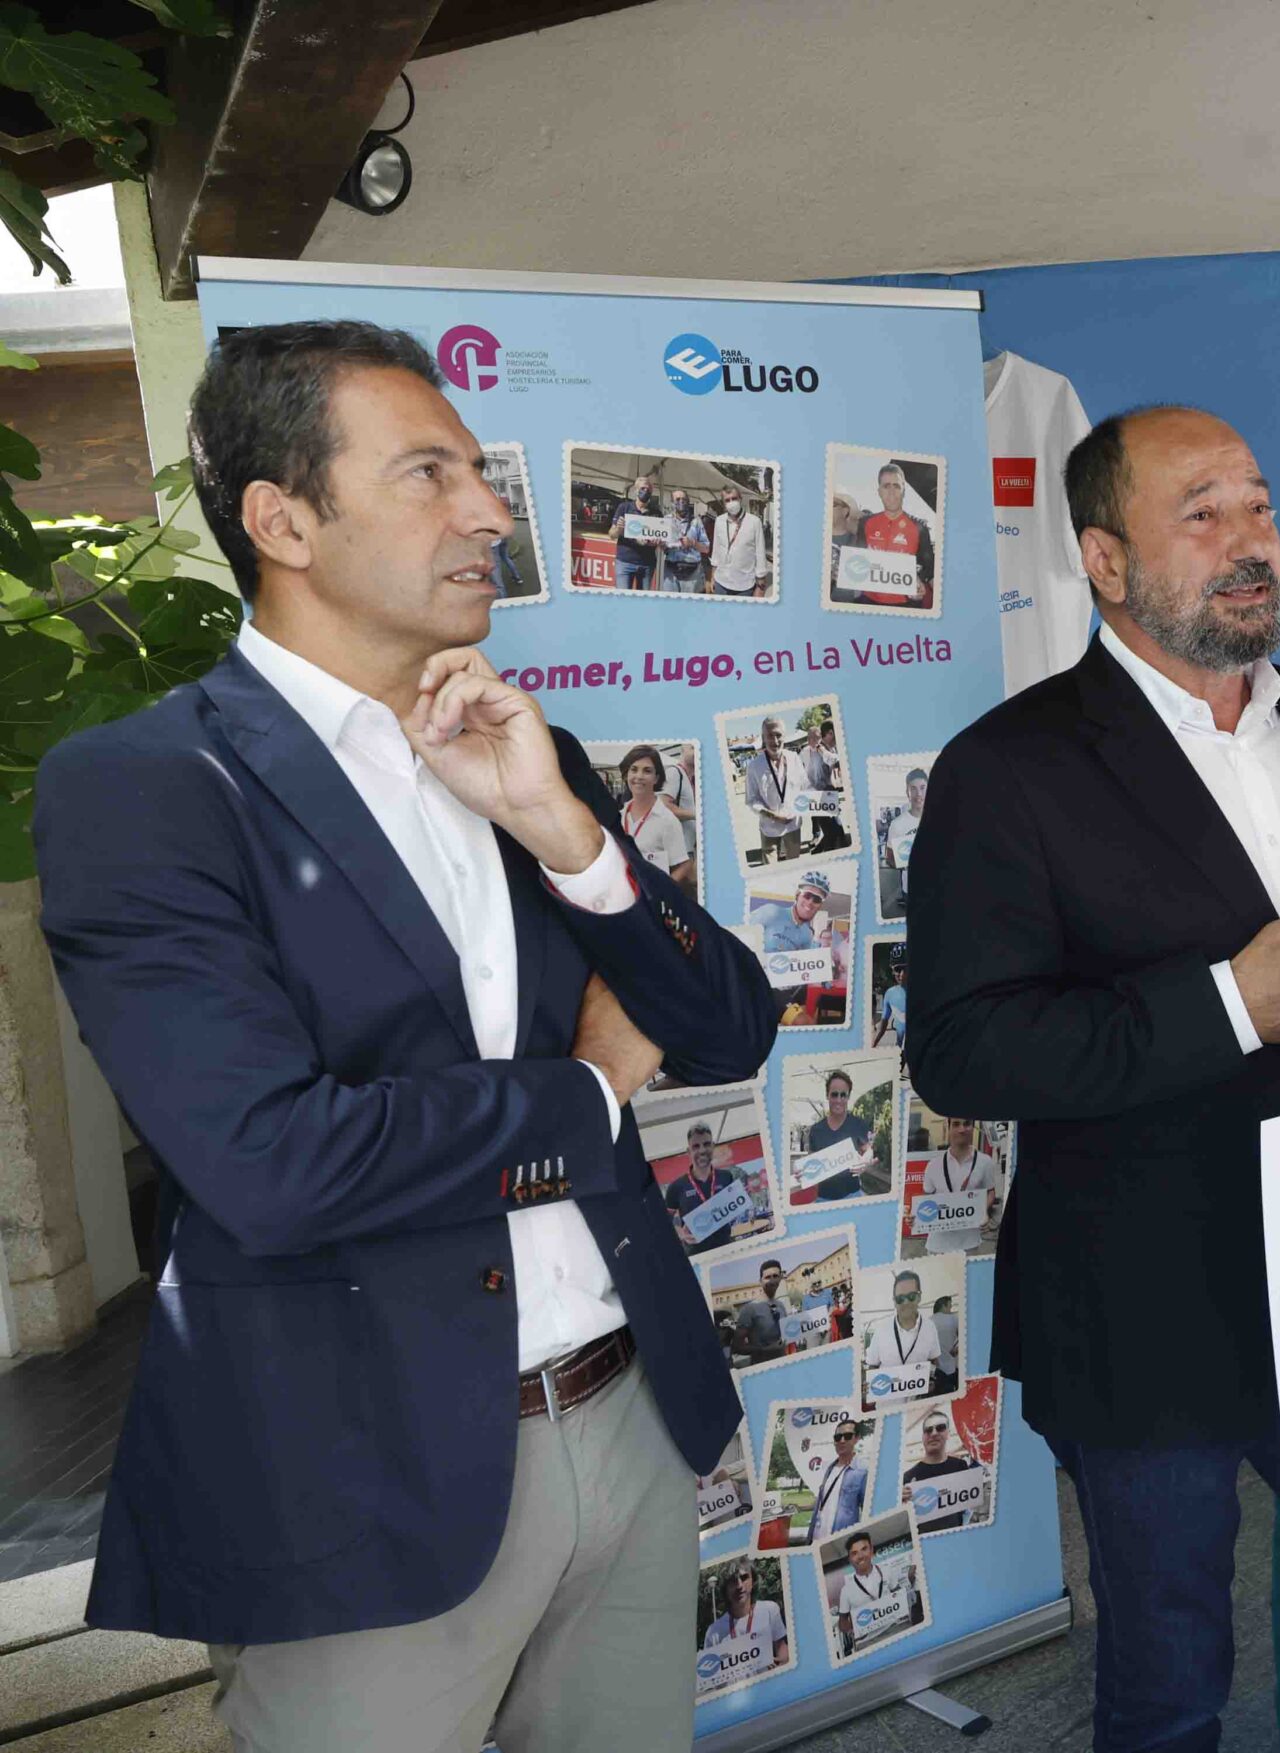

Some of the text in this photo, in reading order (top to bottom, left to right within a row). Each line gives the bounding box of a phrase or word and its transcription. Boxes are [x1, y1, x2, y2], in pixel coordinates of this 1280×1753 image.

[721, 349, 742, 357] PARA
[722, 366, 819, 393] LUGO
[641, 528, 668, 539] LUGO
[870, 570, 913, 586] LUGO
[643, 652, 742, 687] Lugo,
[753, 650, 795, 675] en
[806, 641, 841, 671] La
[850, 635, 952, 668] Vuelta
[809, 803, 836, 811] LUGO
[790, 958, 825, 972] LUGO
[712, 1195, 746, 1222] LUGO
[938, 1206, 975, 1220] LUGO
[801, 1318, 827, 1333] LUGO
[891, 1378, 925, 1392] LUGO
[811, 1412, 850, 1426] LUGO
[699, 1494, 735, 1516] LUGO
[938, 1487, 980, 1509] LUGO
[872, 1603, 900, 1620] LUGO
[720, 1647, 760, 1670] LUGO
